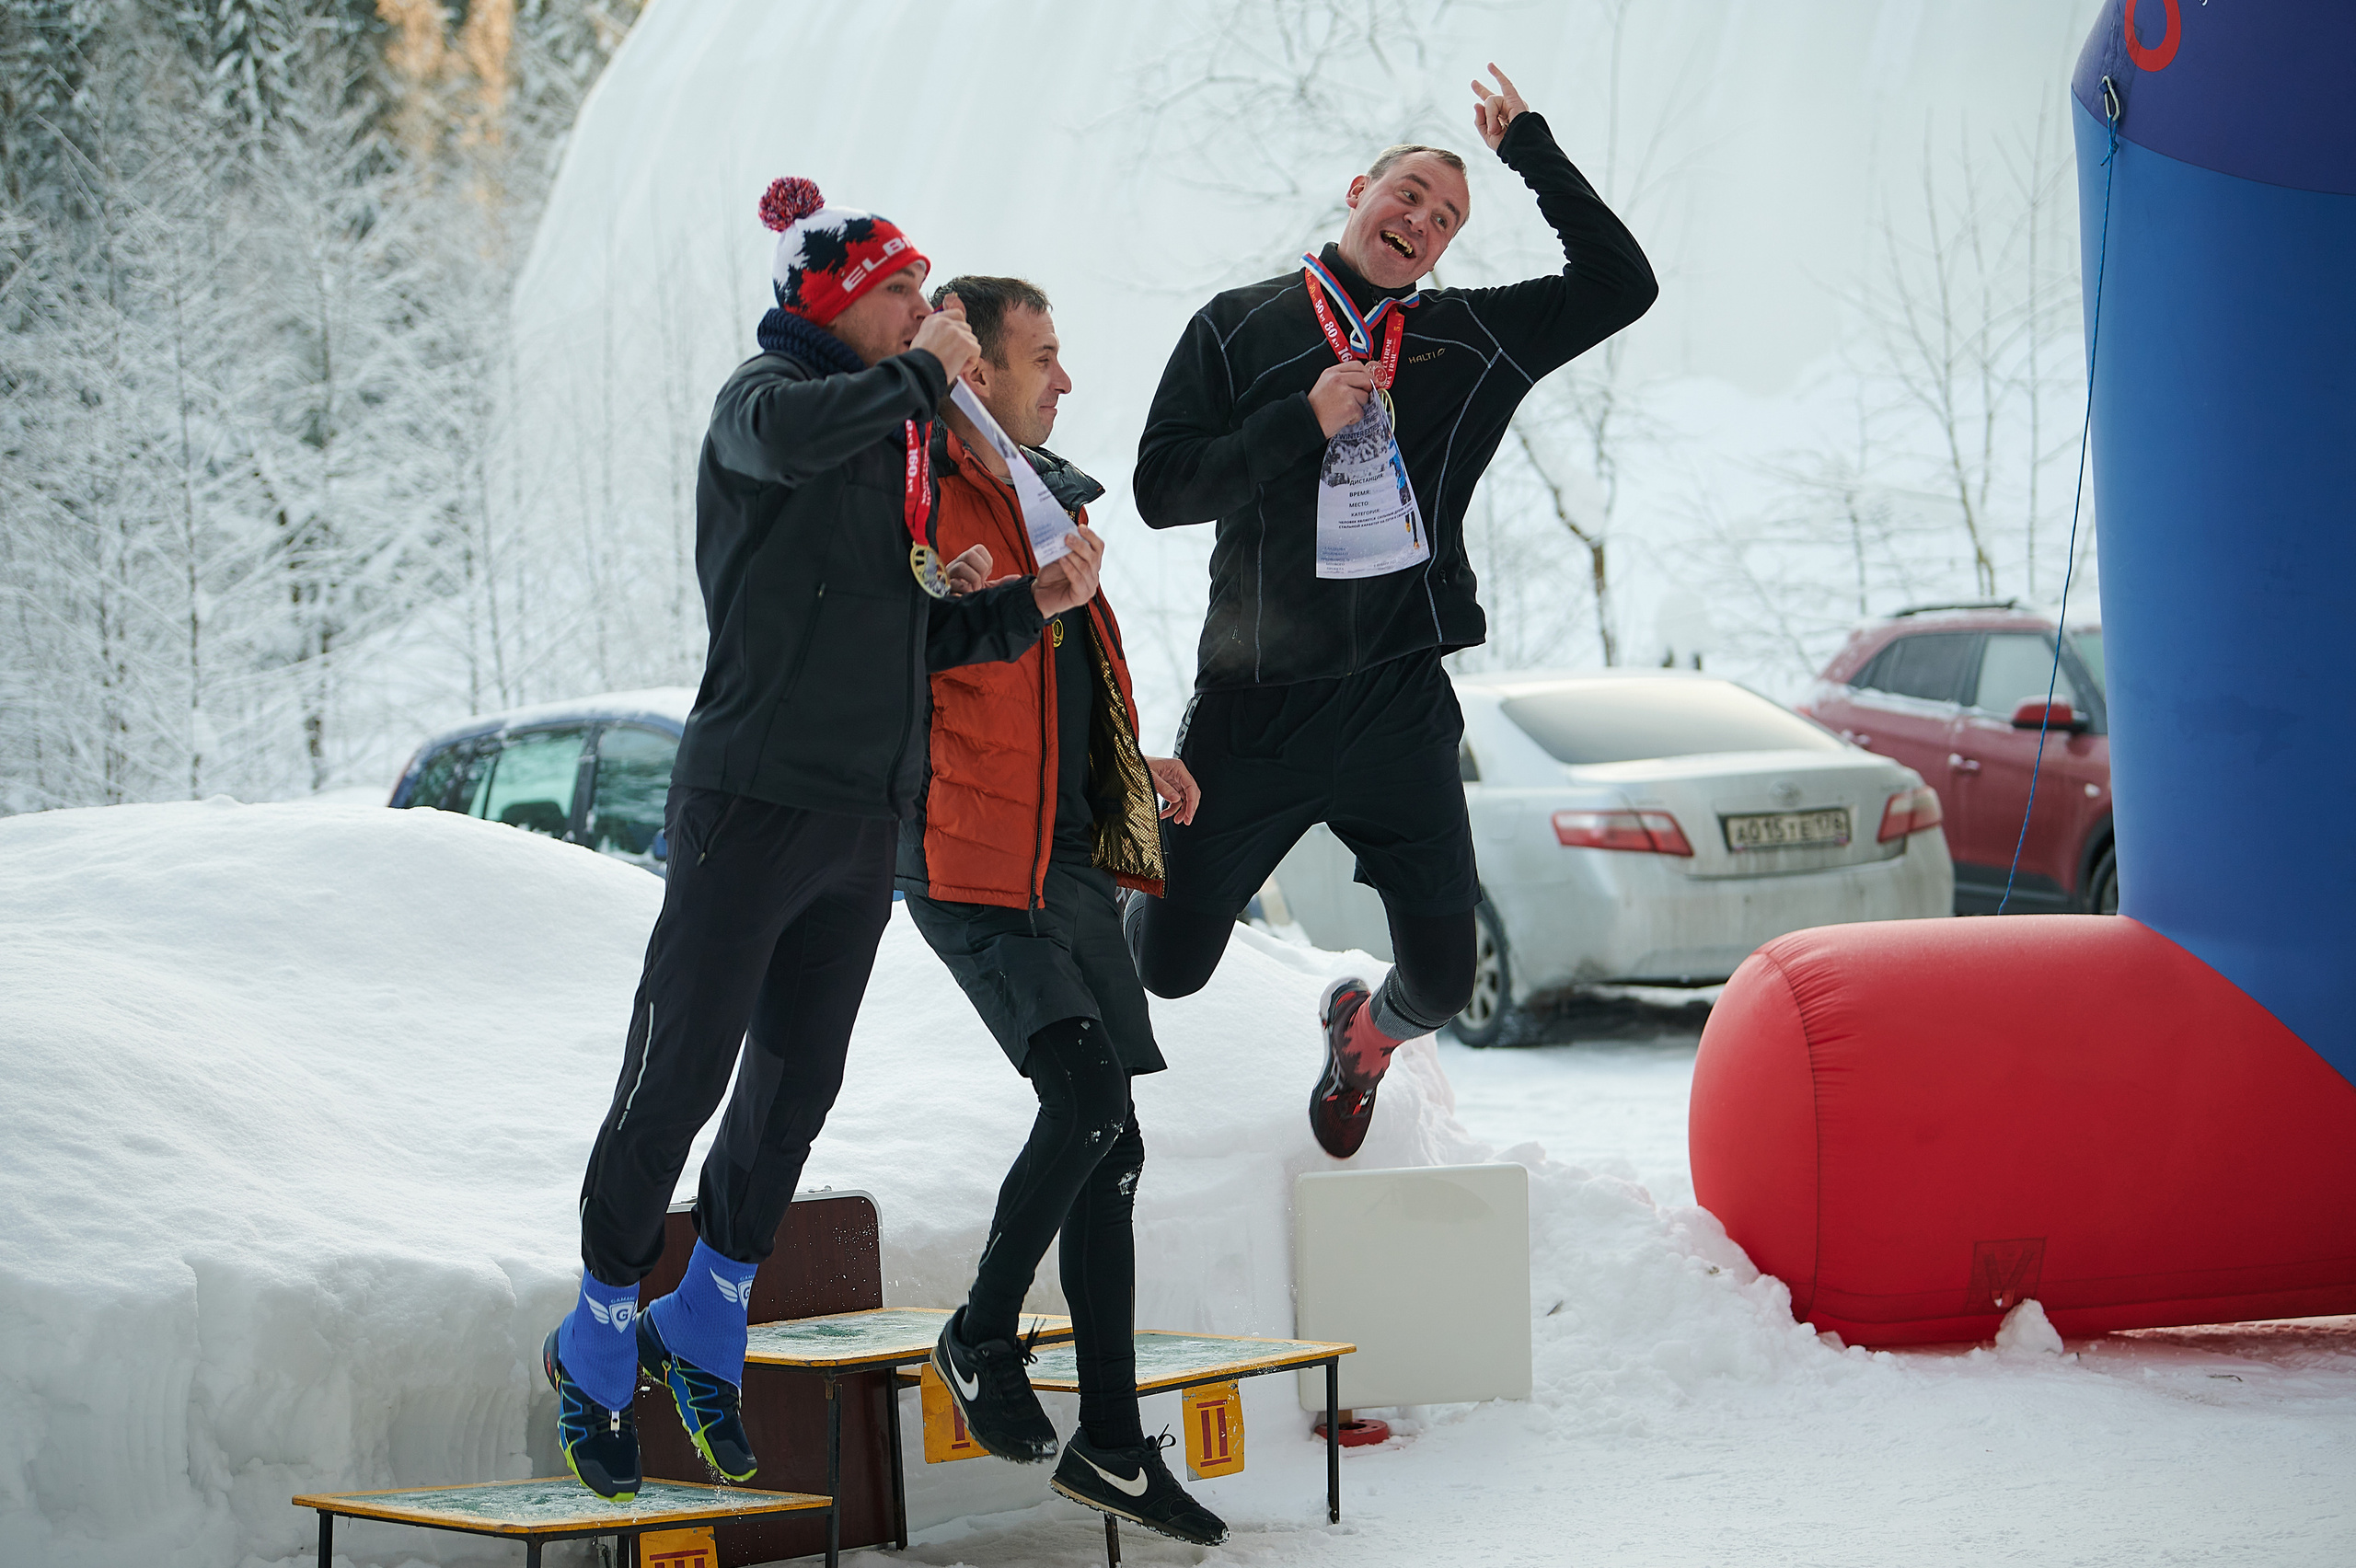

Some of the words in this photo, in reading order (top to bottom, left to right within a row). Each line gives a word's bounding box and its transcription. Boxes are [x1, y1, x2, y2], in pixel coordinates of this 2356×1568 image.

[1315, 298, 1324, 314] 50
[1324, 321, 1338, 338] 80
[1337, 345, 1353, 363] 16
[1408, 351, 1436, 364] HALTI
[907, 447, 918, 478] 160
[1349, 490, 1371, 498] ВРЕМЯ:
[616, 1308, 629, 1322] G
[1196, 1399, 1232, 1468] II
